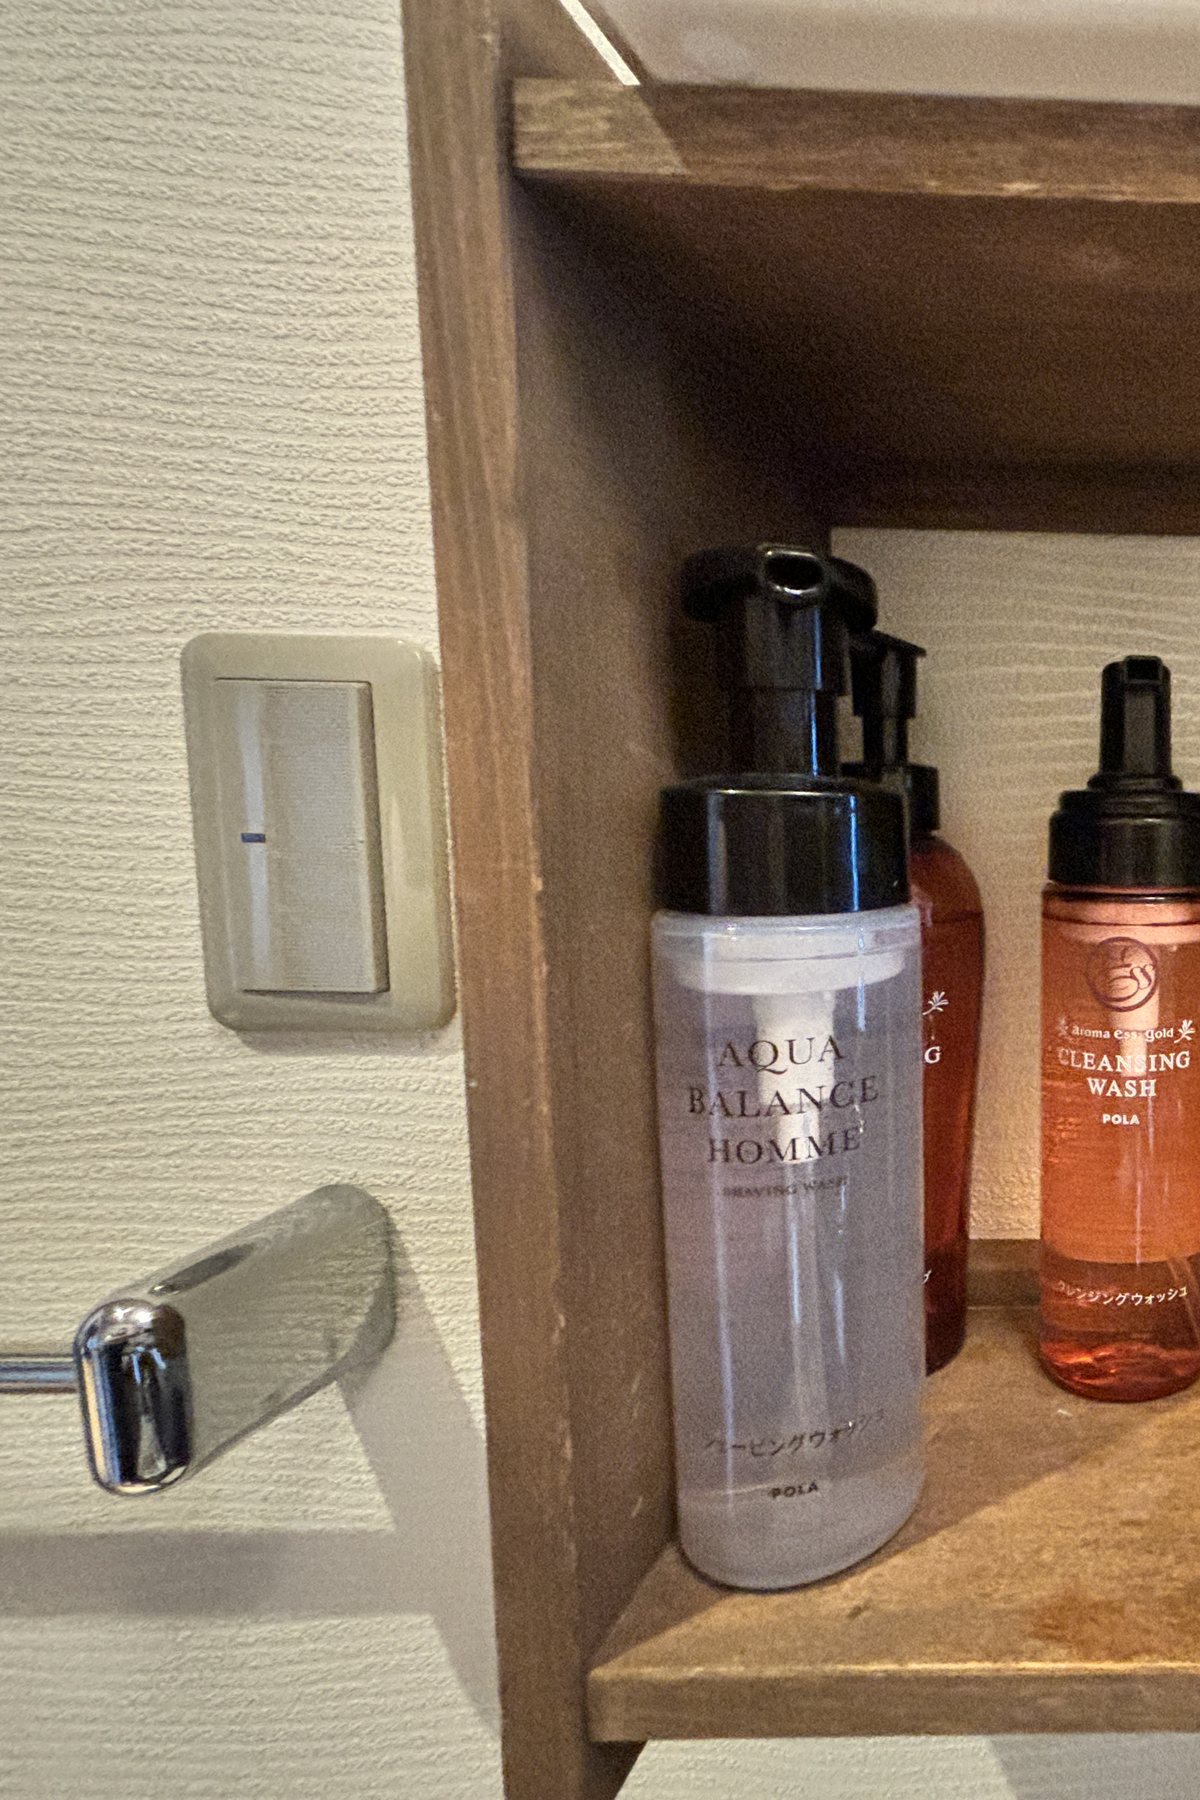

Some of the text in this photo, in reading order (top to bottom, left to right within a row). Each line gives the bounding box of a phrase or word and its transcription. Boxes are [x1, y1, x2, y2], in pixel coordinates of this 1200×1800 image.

[1072, 1024, 1111, 1039] aroma
[1145, 1027, 1174, 1042] gold
[717, 1035, 845, 1076] AQUA
[1057, 1048, 1191, 1073] CLEANSING
[688, 1075, 879, 1118] BALANCE
[1087, 1077, 1157, 1098] WASH
[1102, 1113, 1140, 1126] POLA
[707, 1127, 860, 1165] HOMME
[769, 1481, 819, 1499] POLA
